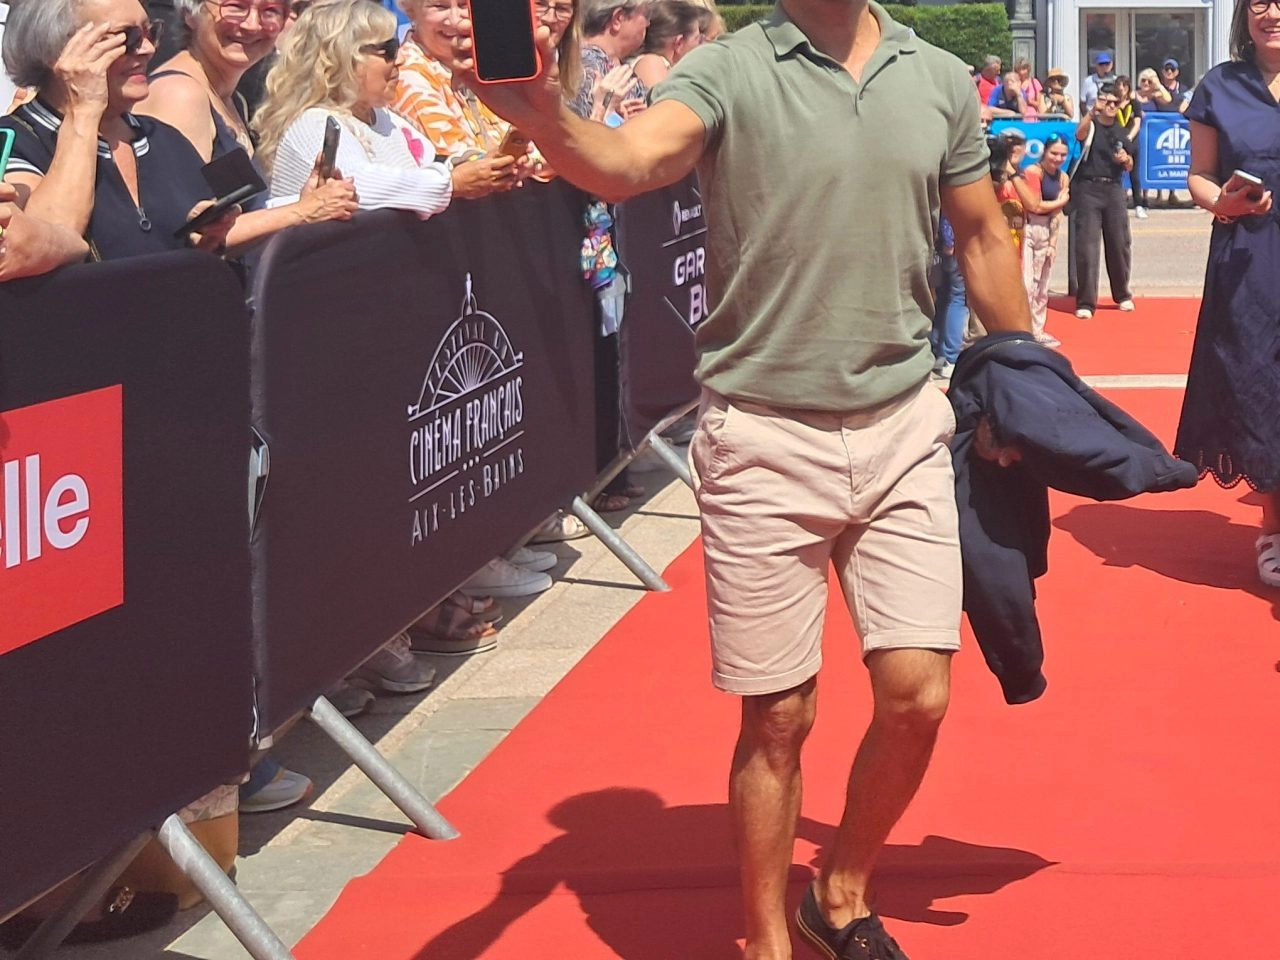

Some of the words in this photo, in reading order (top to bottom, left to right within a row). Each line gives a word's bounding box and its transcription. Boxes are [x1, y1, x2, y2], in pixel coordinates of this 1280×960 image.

[410, 409, 462, 486] CINÉMA
[465, 376, 524, 453] FRANÇAIS
[0, 453, 90, 569] lle
